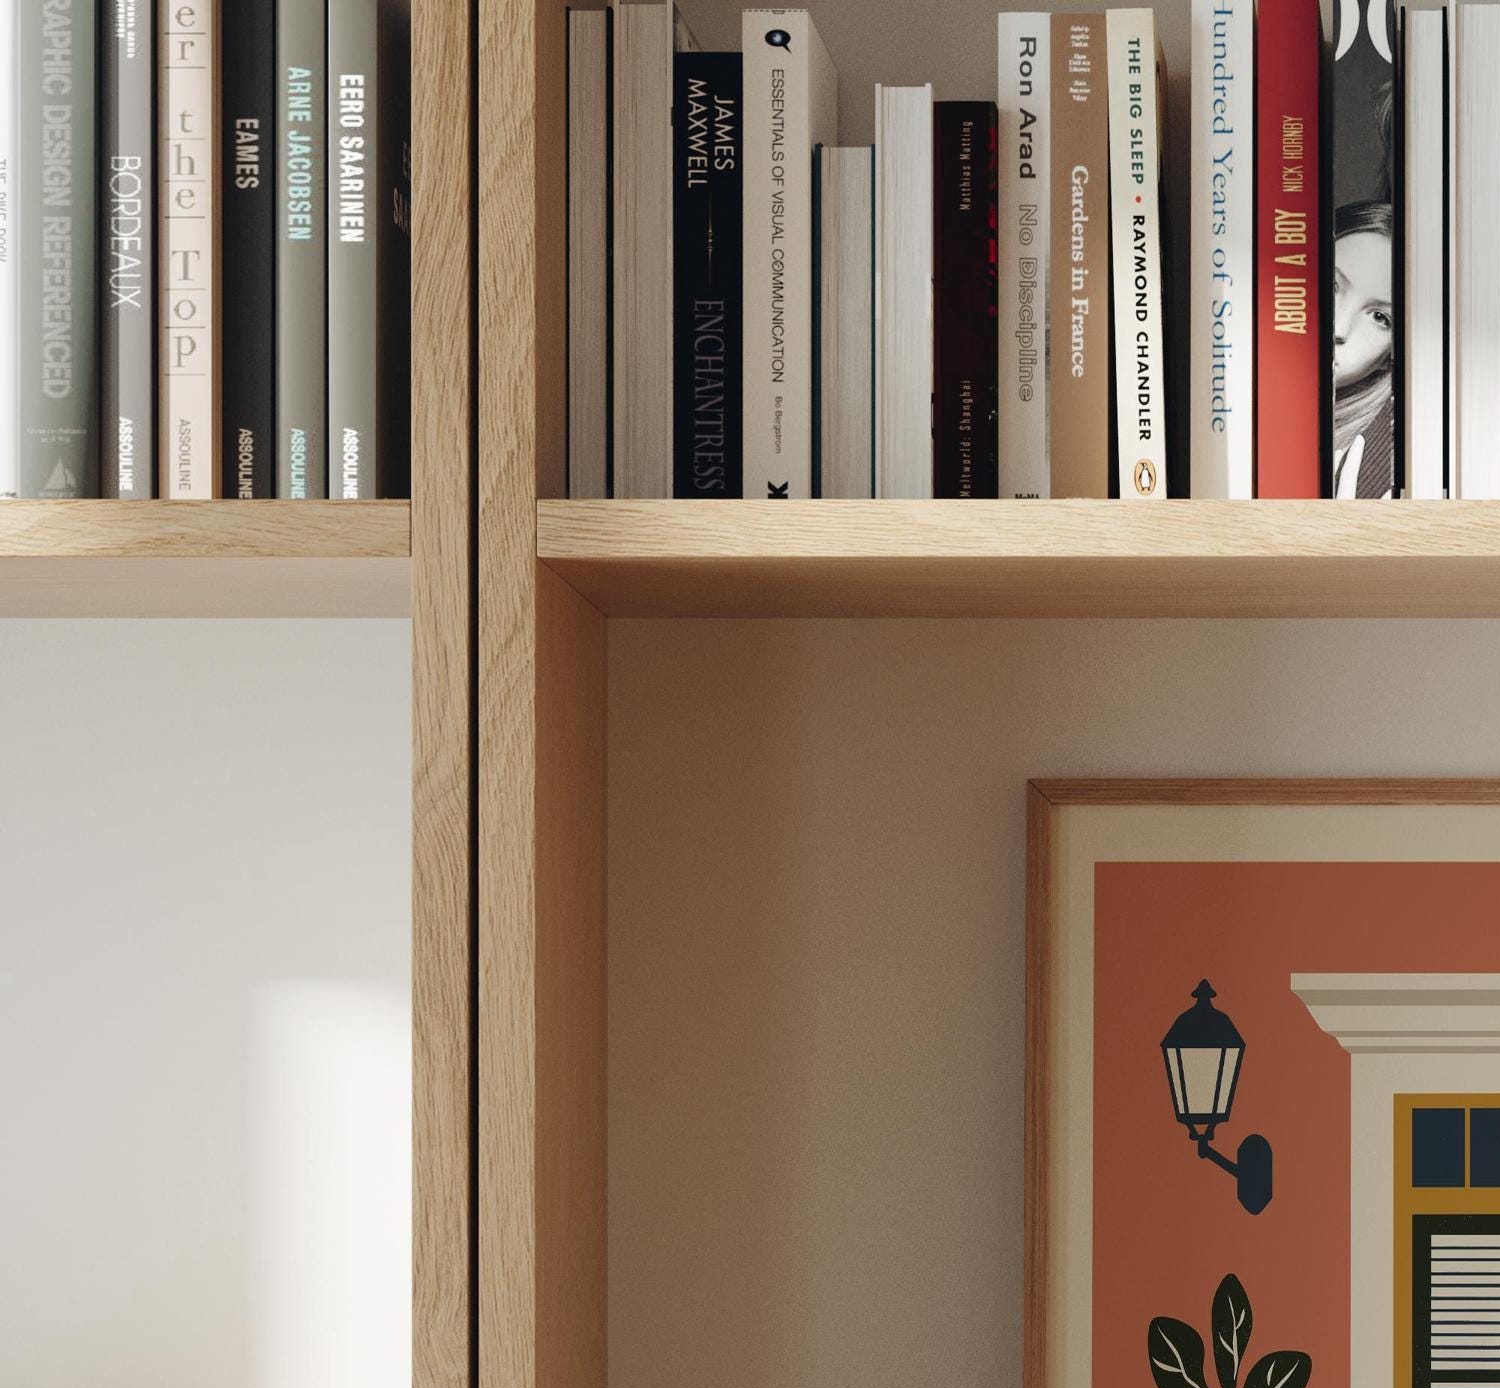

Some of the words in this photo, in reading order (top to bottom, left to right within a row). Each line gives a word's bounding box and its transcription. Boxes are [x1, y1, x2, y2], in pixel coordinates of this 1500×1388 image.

[1019, 36, 1036, 96] Ron
[1128, 38, 1141, 75] THE
[288, 67, 311, 122] ARNE
[339, 74, 365, 128] EERO
[772, 69, 784, 162] ESSENTIALS
[1129, 84, 1142, 119] BIG
[43, 103, 72, 206] DESIGN
[235, 118, 259, 189] EAMES
[688, 78, 708, 189] MAXWELL
[715, 95, 735, 170] JAMES
[1019, 108, 1036, 179] Arad
[1130, 129, 1144, 184] SLEEP
[1283, 115, 1303, 159] HORNBY
[288, 131, 311, 240] JACOBSEN
[339, 137, 365, 243] SAARINEN
[772, 166, 784, 187] OF
[1212, 147, 1234, 236] Years
[1283, 166, 1303, 192] NICK
[110, 155, 141, 308] BORDEAUX
[772, 190, 784, 243] VISUAL
[1019, 204, 1036, 246] No
[1071, 165, 1089, 262] Gardens
[1274, 208, 1306, 245] BOY
[1071, 266, 1089, 291] in
[1133, 215, 1148, 322] RAYMOND
[1212, 247, 1234, 285] of
[1274, 254, 1306, 266] A
[43, 215, 72, 398] REFERENCED
[172, 249, 199, 368] Top
[772, 248, 784, 382] COMMUNICATION
[1015, 257, 1037, 403] Discipline
[1071, 297, 1089, 377] France
[1274, 275, 1306, 335] ABOUT
[693, 299, 725, 490] ENCHANTRESS
[1136, 332, 1151, 441] CHANDLER
[1212, 299, 1234, 433] Solitude
[118, 416, 133, 492] ASSOULINE
[179, 419, 191, 490] ASSOULINE
[238, 428, 253, 498] ASSOULINE
[291, 428, 305, 498] ASSOULINE
[343, 428, 358, 498] ASSOULINE
